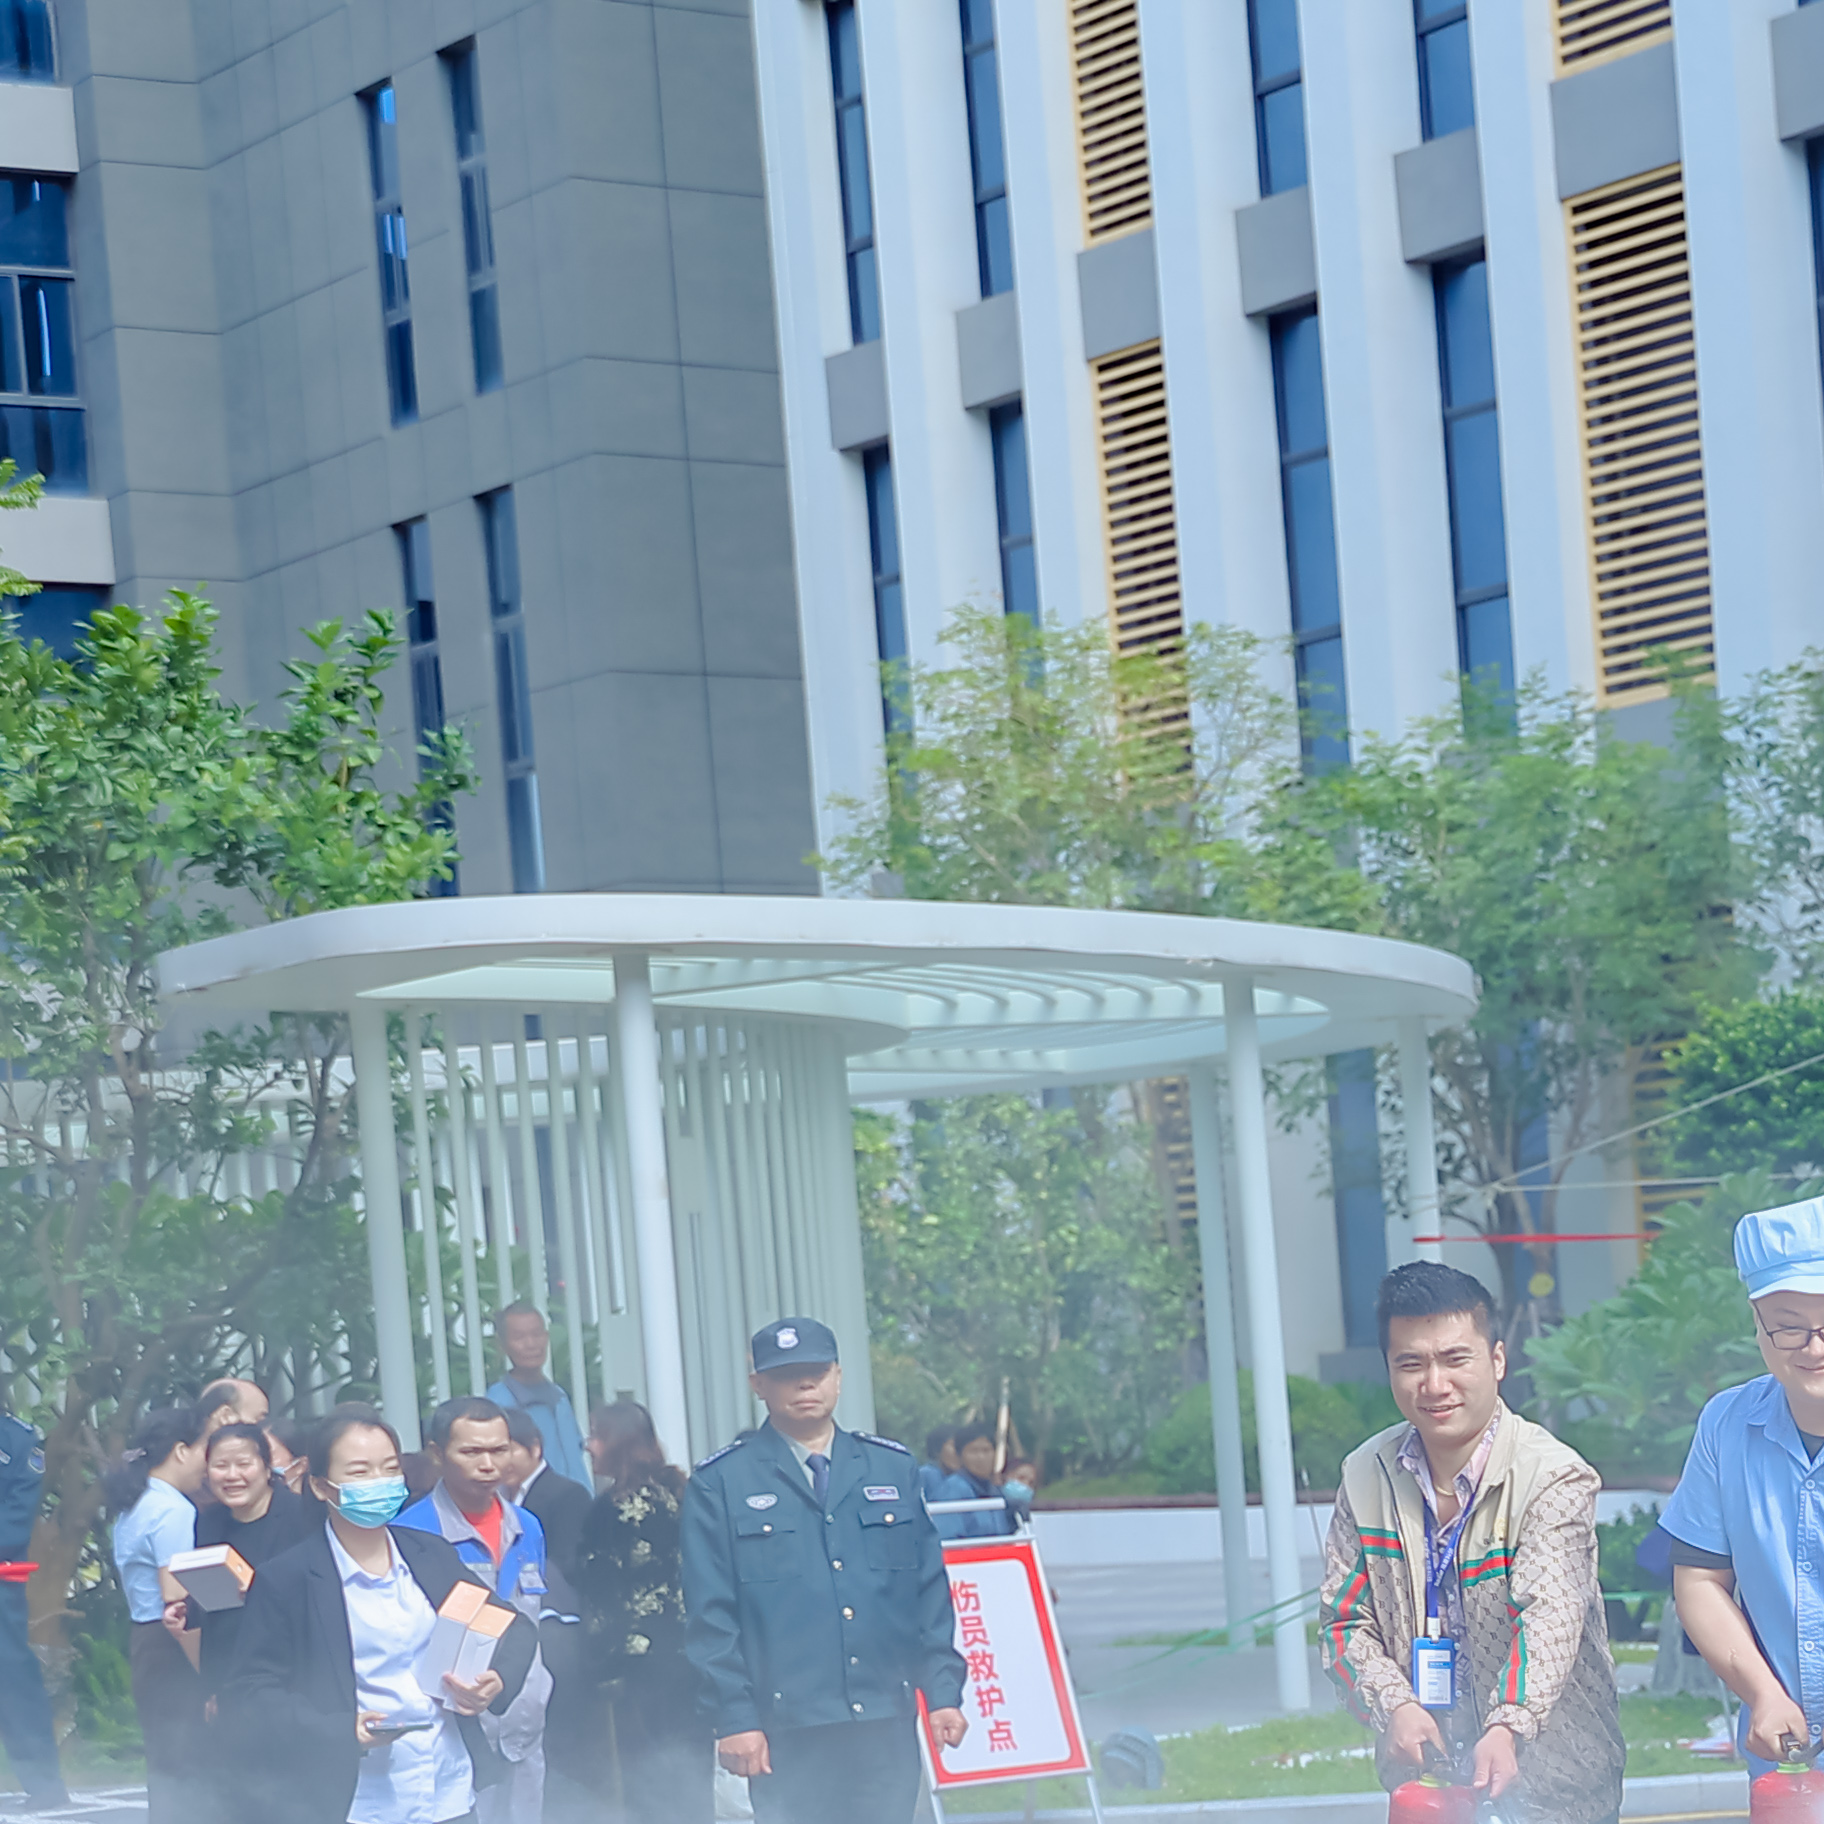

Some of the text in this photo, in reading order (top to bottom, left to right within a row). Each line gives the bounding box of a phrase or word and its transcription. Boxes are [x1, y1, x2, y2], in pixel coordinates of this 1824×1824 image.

[950, 1580, 1019, 1752] 伤员救护点
